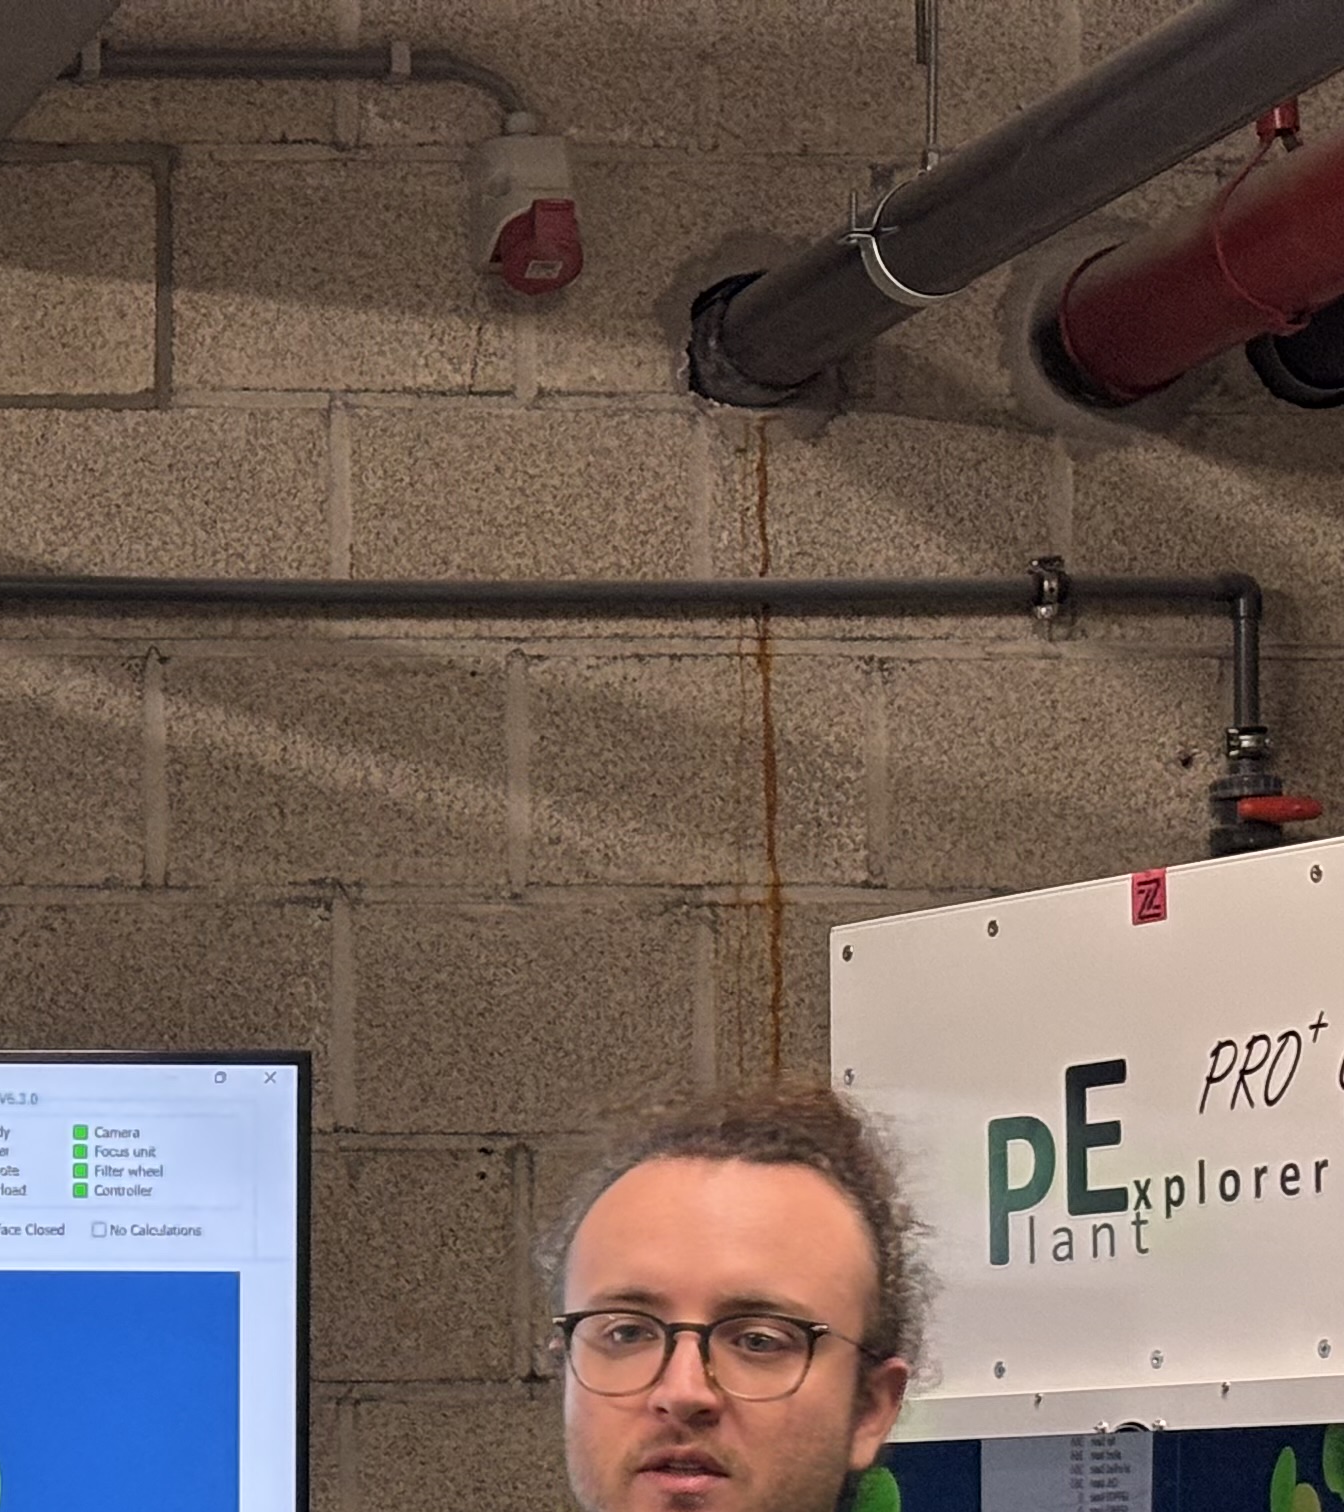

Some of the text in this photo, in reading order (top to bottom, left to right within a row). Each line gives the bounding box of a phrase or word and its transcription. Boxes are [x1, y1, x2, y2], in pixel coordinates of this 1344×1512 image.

[94, 1126, 140, 1139] Camera
[95, 1146, 156, 1158] Focus unit
[95, 1165, 163, 1177] Filter wheel
[94, 1184, 152, 1197] Controller
[25, 1223, 65, 1236] Closed
